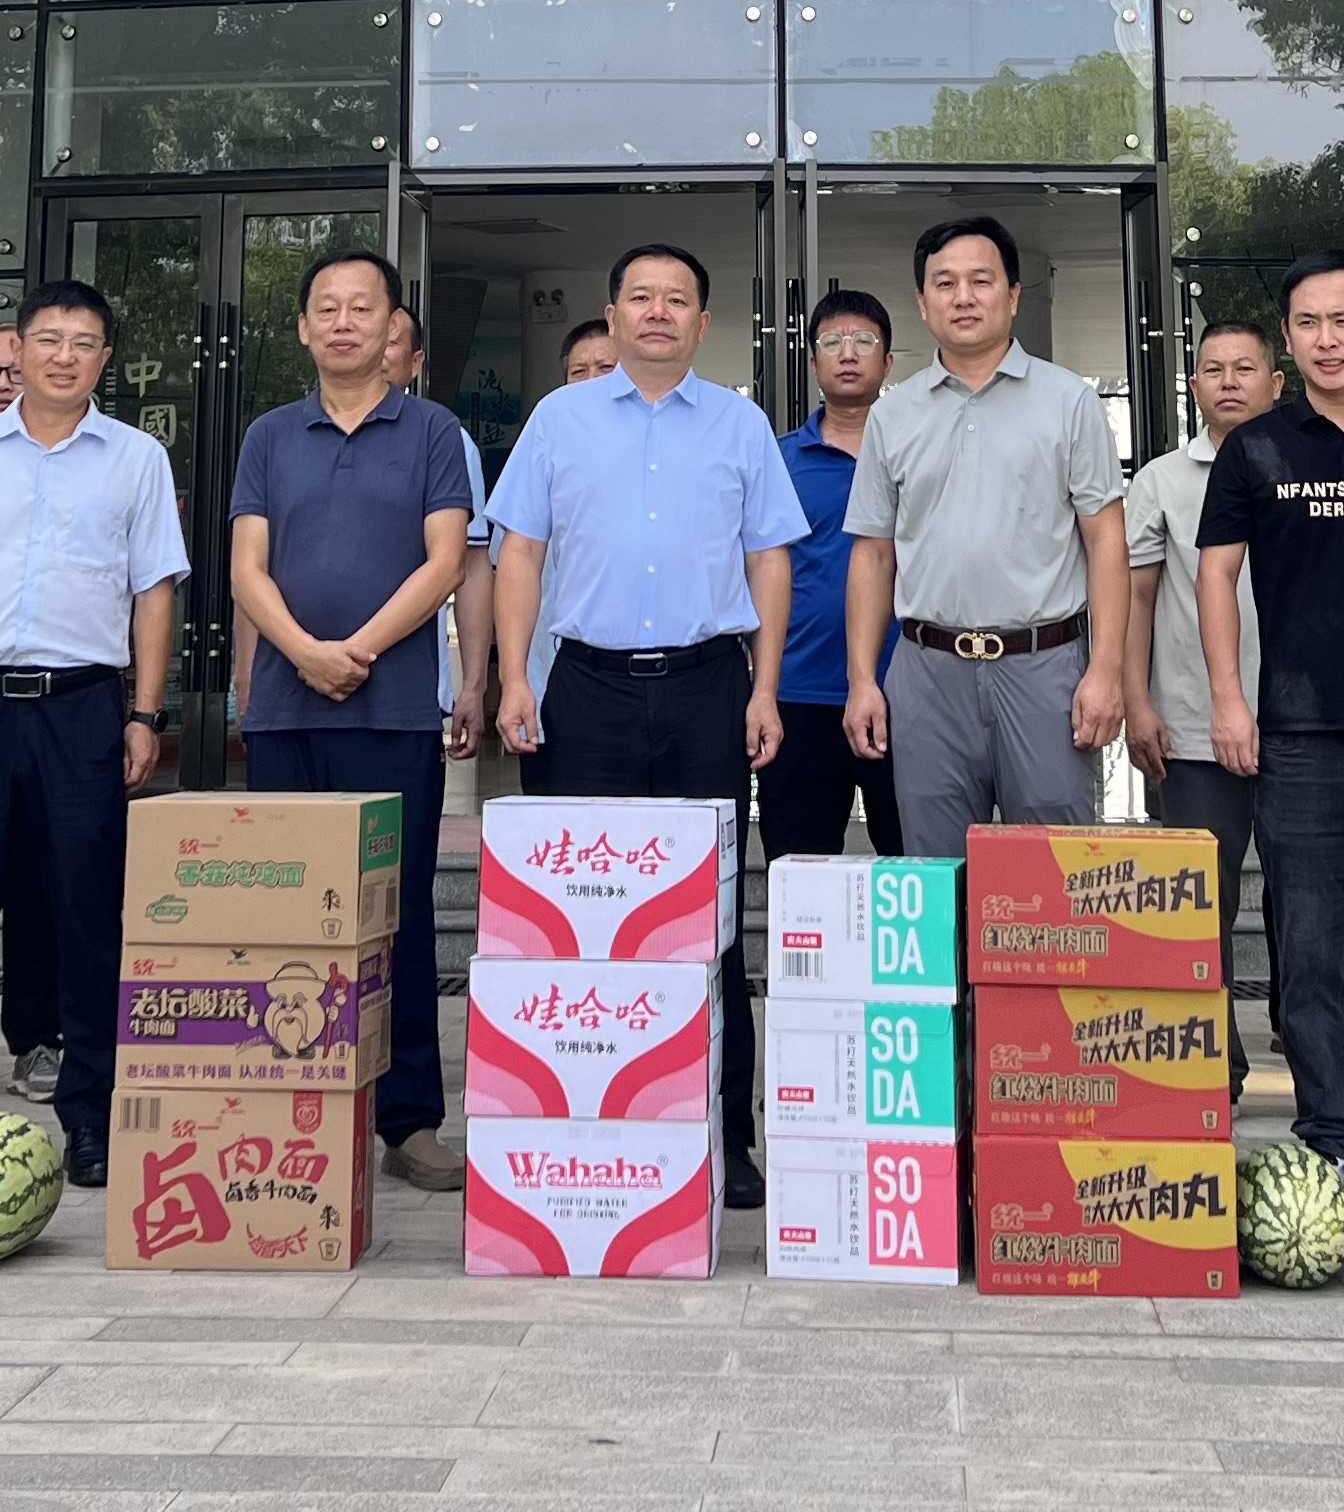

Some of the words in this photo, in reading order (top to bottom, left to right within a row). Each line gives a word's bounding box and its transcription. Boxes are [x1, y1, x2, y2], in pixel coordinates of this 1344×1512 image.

[178, 838, 220, 855] 统一
[526, 828, 671, 875] 娃哈哈
[566, 883, 628, 898] 饮用纯净水
[1066, 859, 1135, 893] 全新升级
[982, 895, 1040, 919] 统一
[982, 923, 1107, 955] 红烧牛肉面
[133, 959, 176, 976] 统一
[130, 987, 249, 1020] 老坛酸菜
[514, 984, 661, 1031] 娃哈哈
[129, 1018, 177, 1037] 牛肉面
[1074, 1007, 1144, 1041] 全新升级
[555, 1040, 617, 1055] 饮用纯净水
[990, 1044, 1050, 1069] 统一
[126, 1063, 232, 1080] 老坛酸菜牛肉面
[239, 1064, 348, 1081] 认准统一是关键
[990, 1073, 1117, 1104] 红烧牛肉面
[171, 1119, 220, 1137] 统一
[506, 1150, 663, 1189] Wahaha
[1076, 1165, 1147, 1199] 全新升级
[132, 1134, 329, 1260] 卤肉面
[991, 1203, 1053, 1229] 统一
[991, 1232, 1121, 1265] 红烧牛肉面
